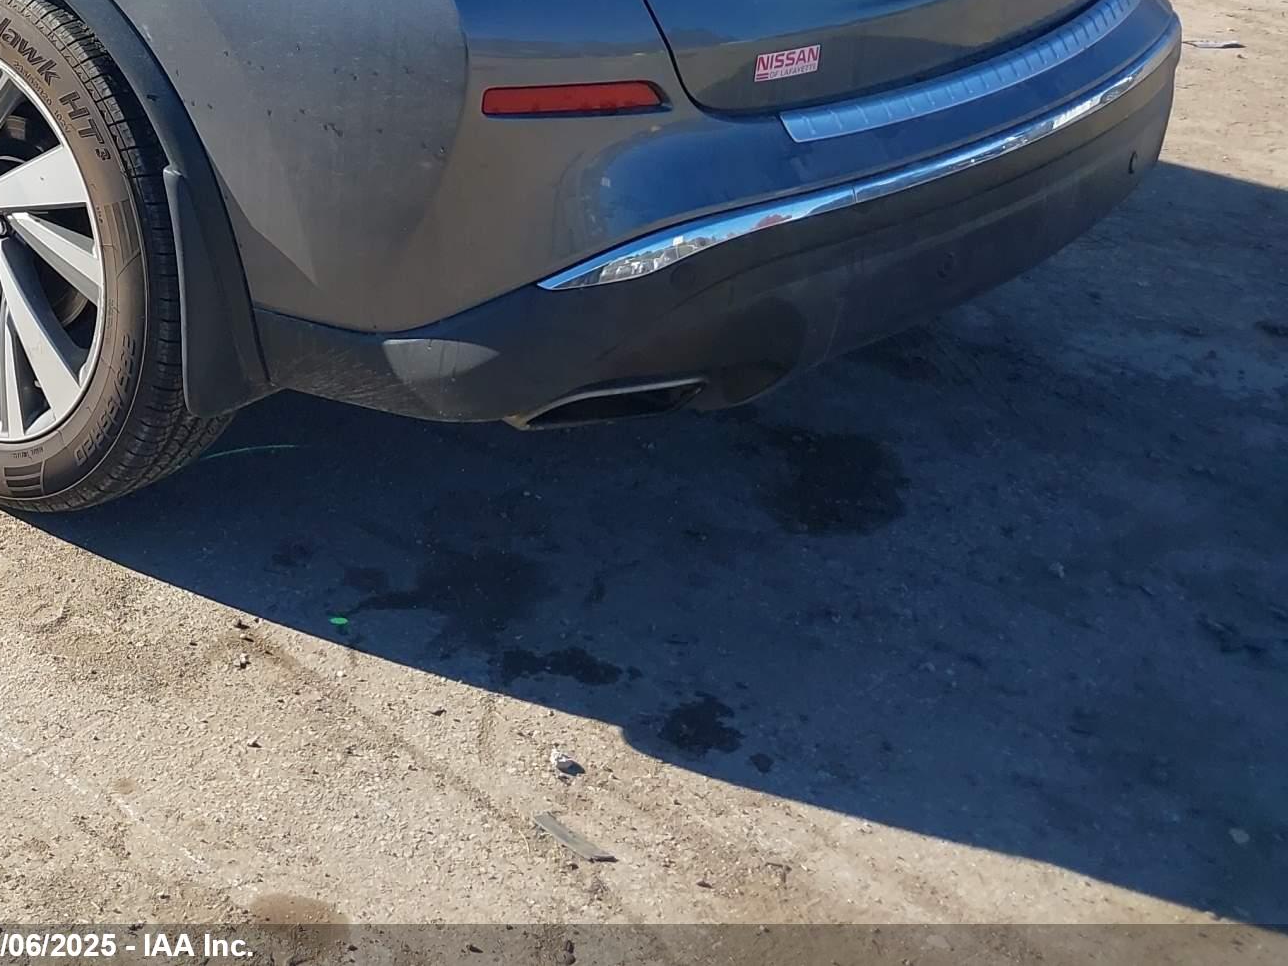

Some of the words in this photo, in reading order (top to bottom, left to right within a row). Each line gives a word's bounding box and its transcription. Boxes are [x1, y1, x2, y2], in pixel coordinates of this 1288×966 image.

[757, 46, 819, 72] NISSAN
[769, 70, 778, 78] OF
[780, 63, 817, 76] LAFAYETTE
